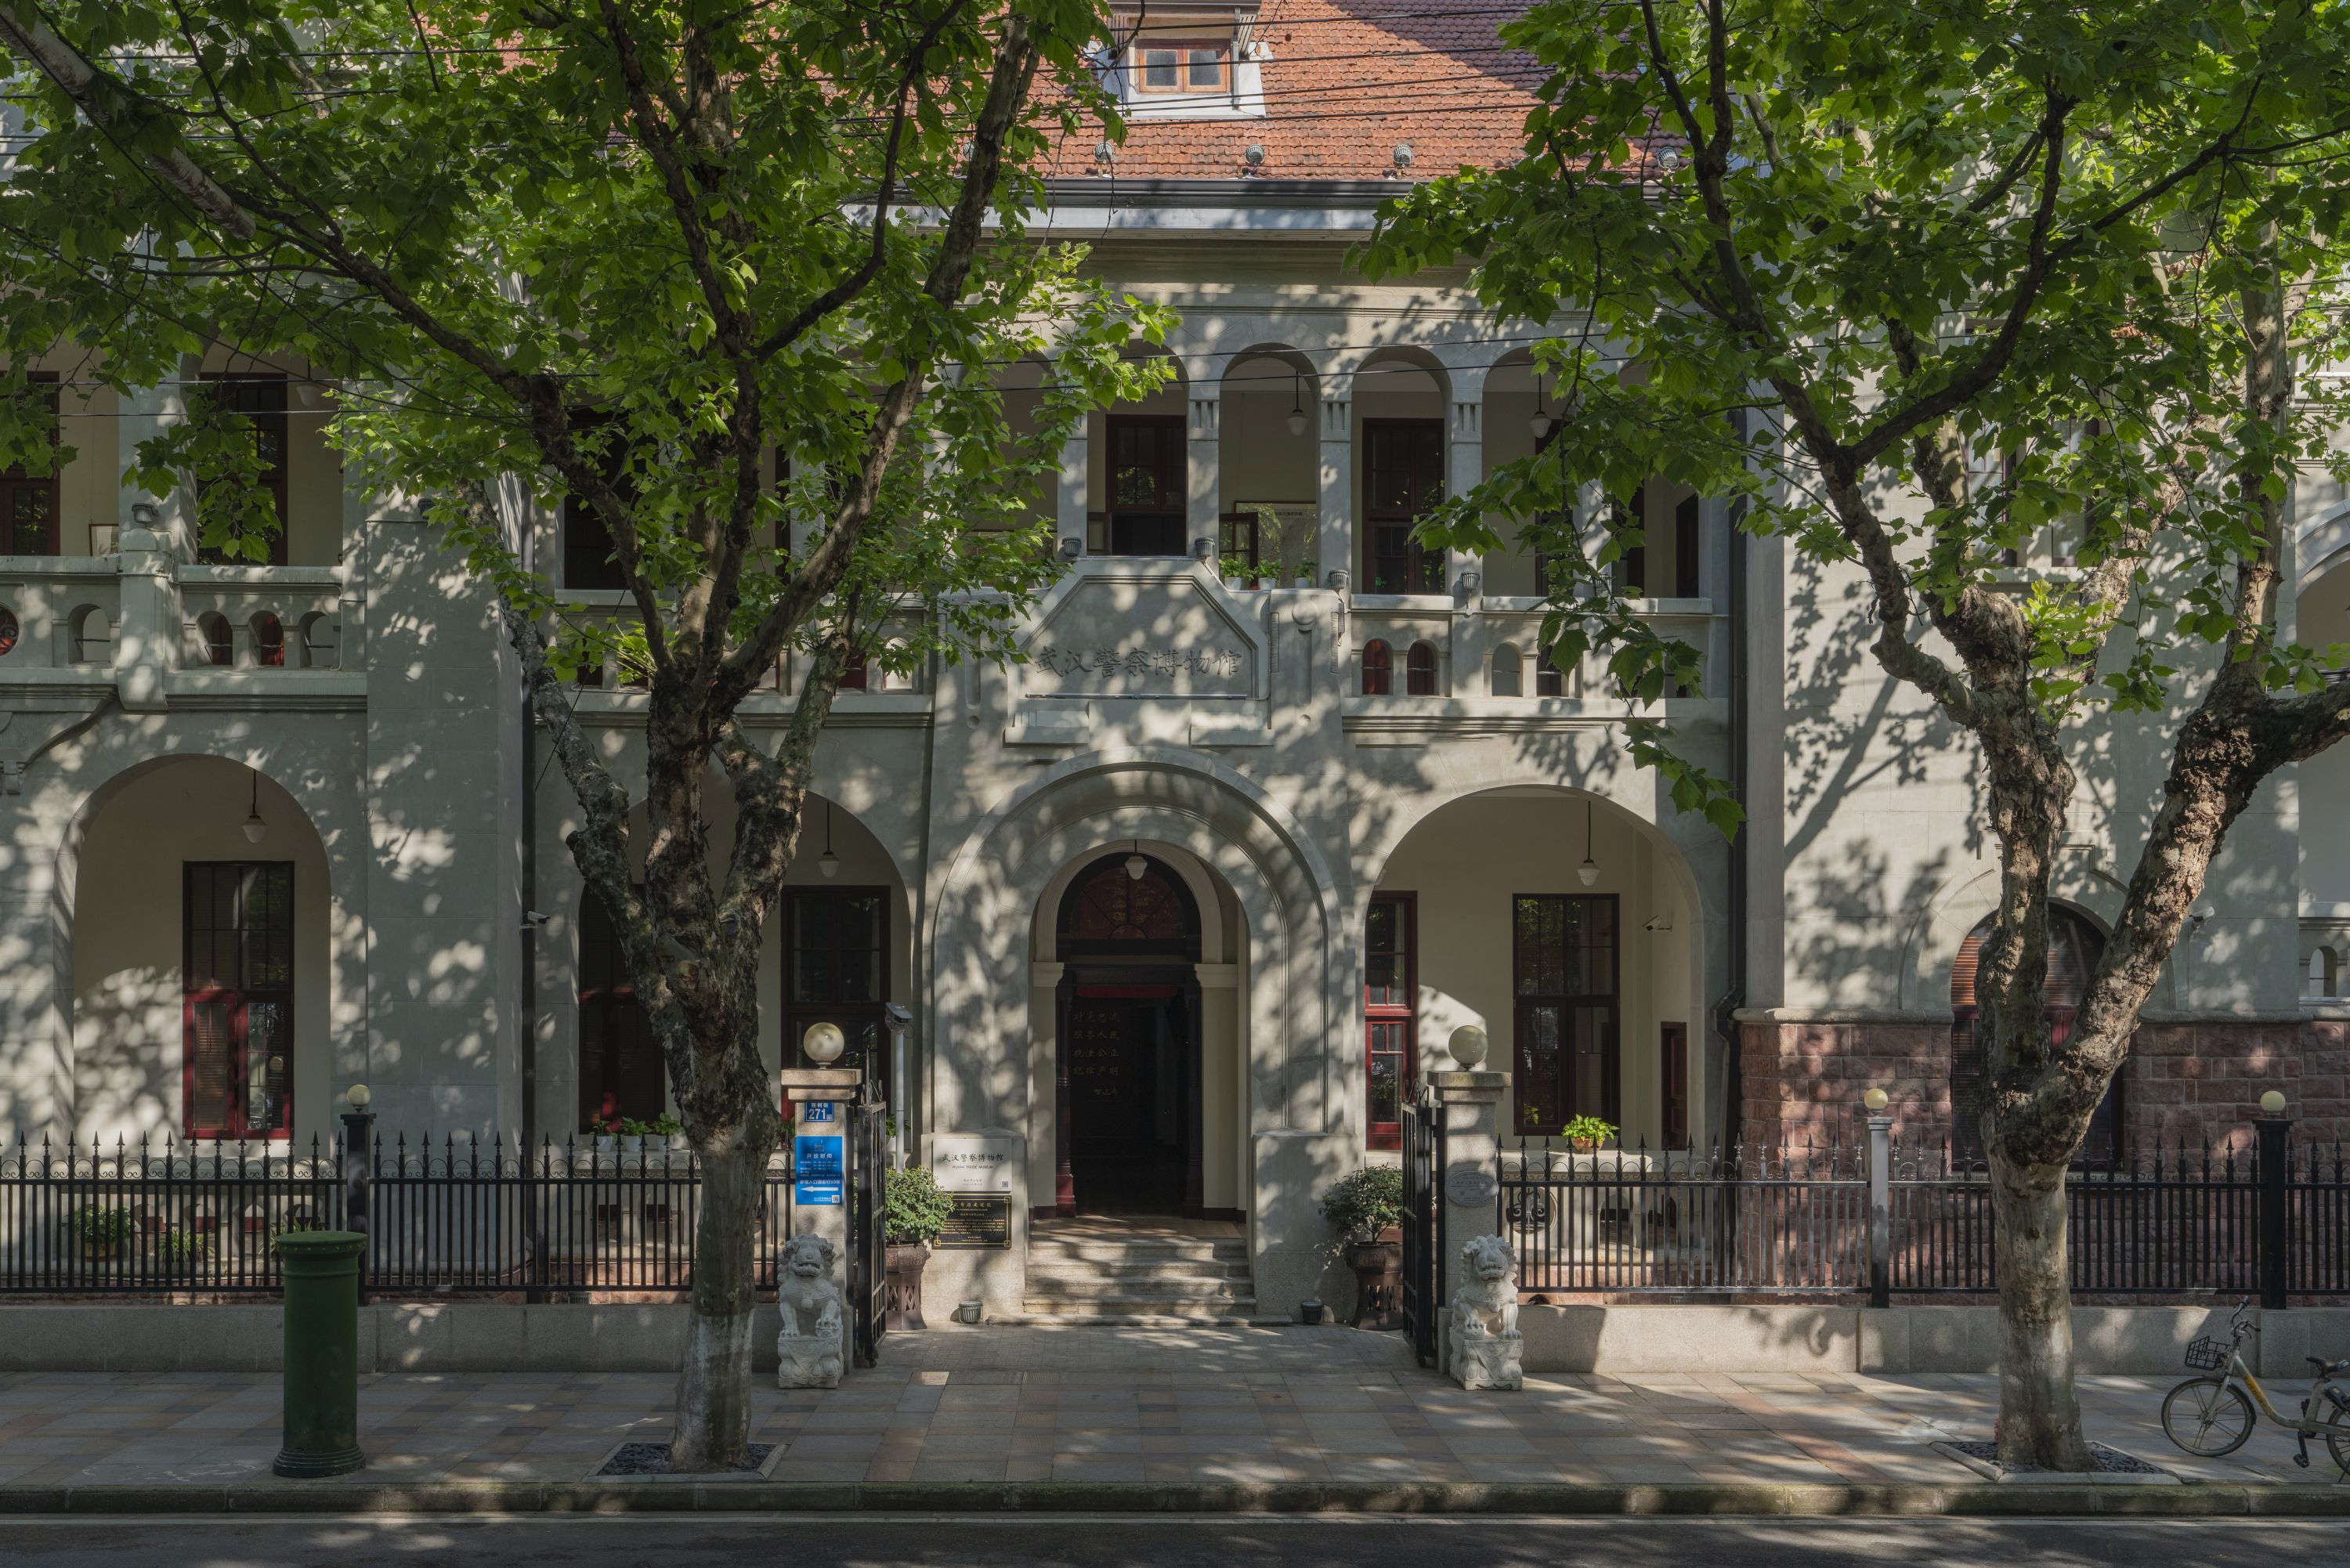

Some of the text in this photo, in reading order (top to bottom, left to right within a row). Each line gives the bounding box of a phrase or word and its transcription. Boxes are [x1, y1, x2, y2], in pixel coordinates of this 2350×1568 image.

[1035, 645, 1242, 677] 武汉警察博物馆
[808, 1108, 826, 1119] 271
[942, 1153, 1003, 1162] 武汉警察博物馆
